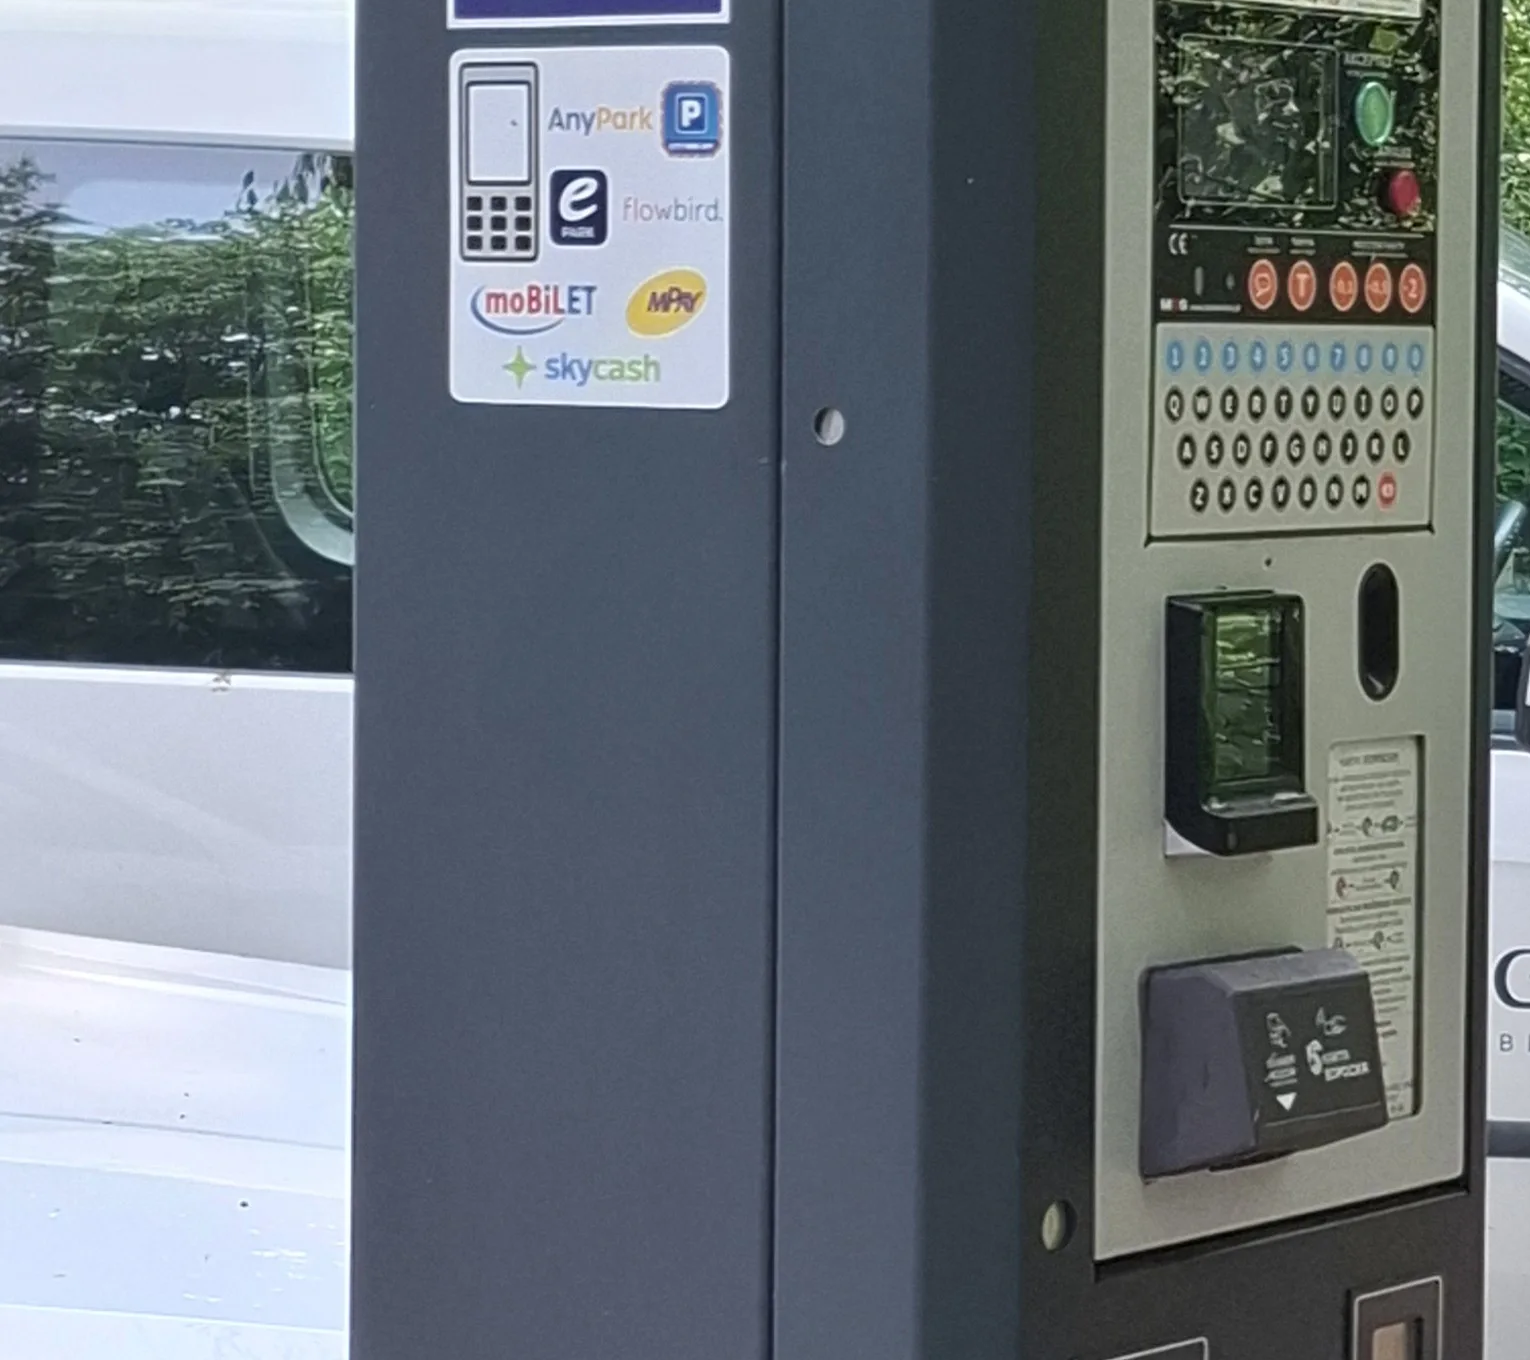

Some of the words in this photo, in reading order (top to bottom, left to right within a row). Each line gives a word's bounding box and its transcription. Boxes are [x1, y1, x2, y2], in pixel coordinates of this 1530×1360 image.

[548, 106, 653, 135] AnyPark
[681, 100, 702, 128] P
[558, 177, 598, 222] e
[485, 285, 598, 315] moBiLET
[544, 352, 661, 387] skycash
